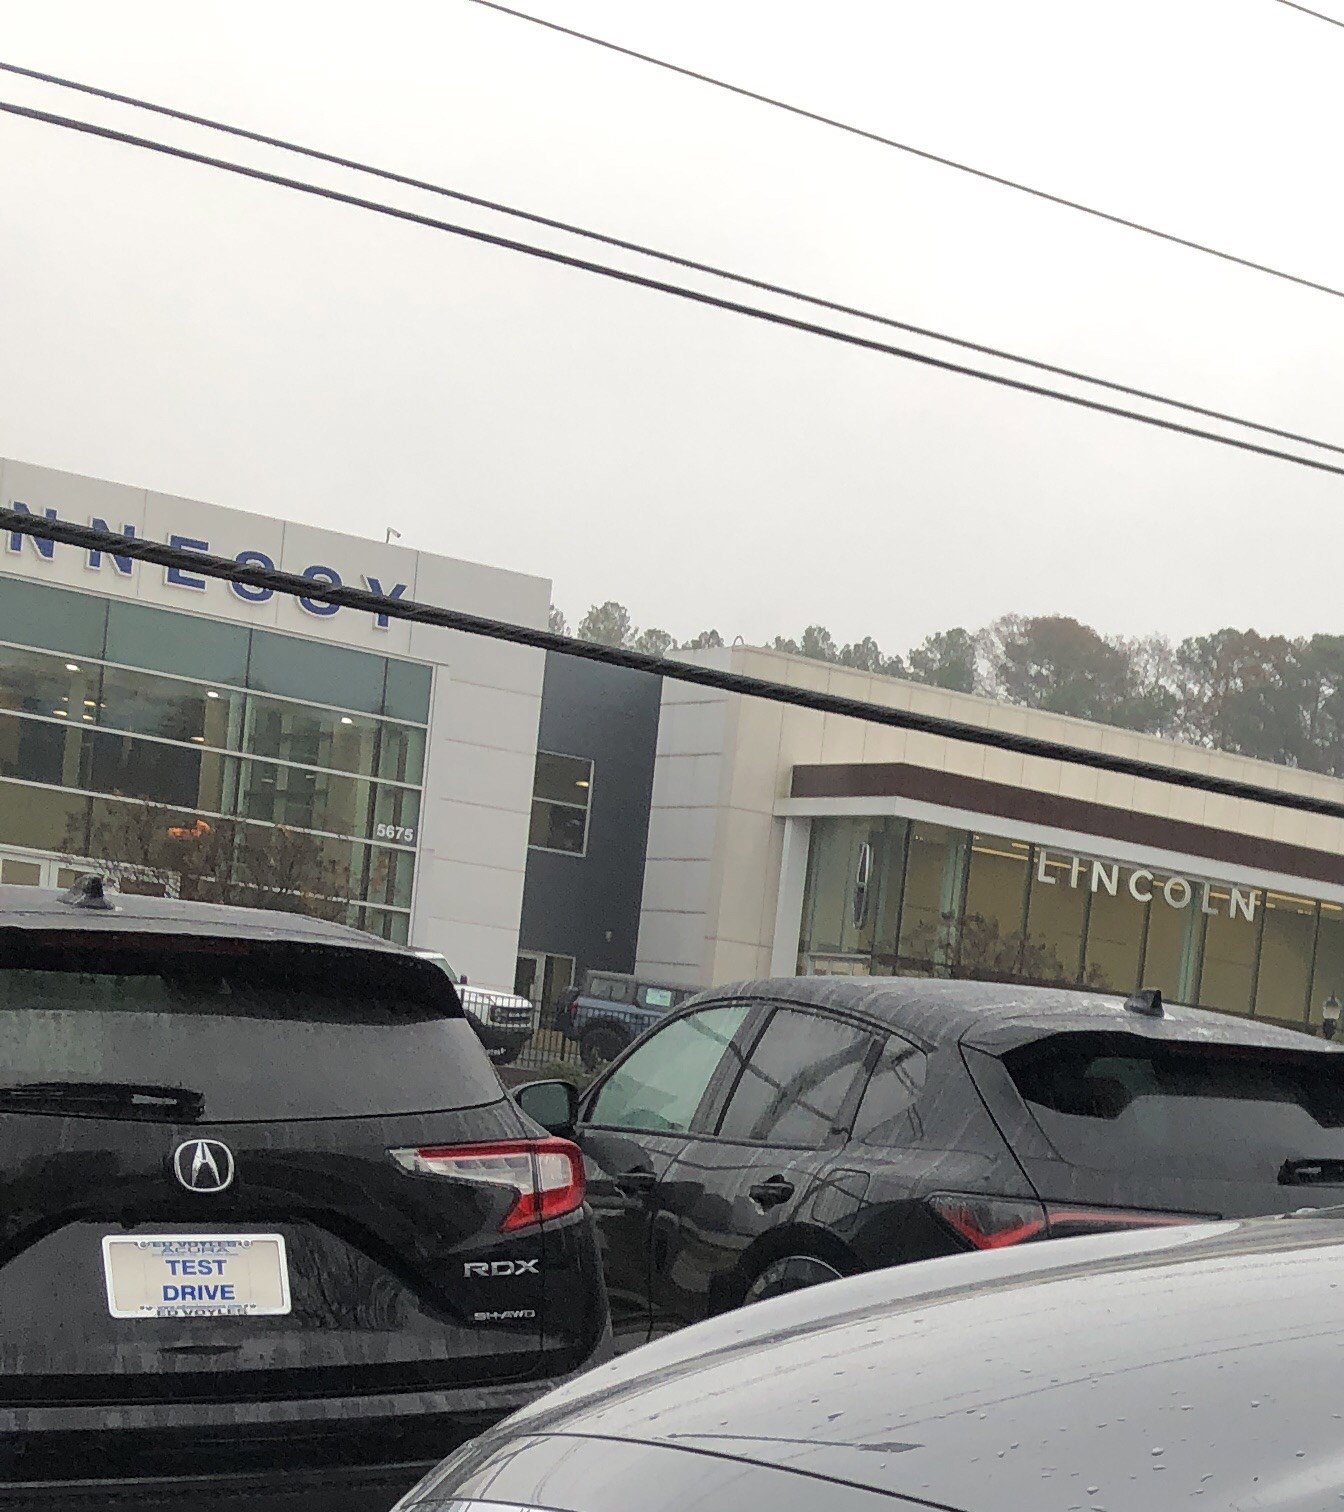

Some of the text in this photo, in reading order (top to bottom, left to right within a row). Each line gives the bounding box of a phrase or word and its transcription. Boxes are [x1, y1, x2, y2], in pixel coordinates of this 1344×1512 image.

[376, 823, 414, 842] 5675
[1037, 850, 1256, 922] LINCOLN
[165, 1259, 227, 1276] TEST
[463, 1259, 539, 1278] RDX
[162, 1284, 235, 1301] DRIVE
